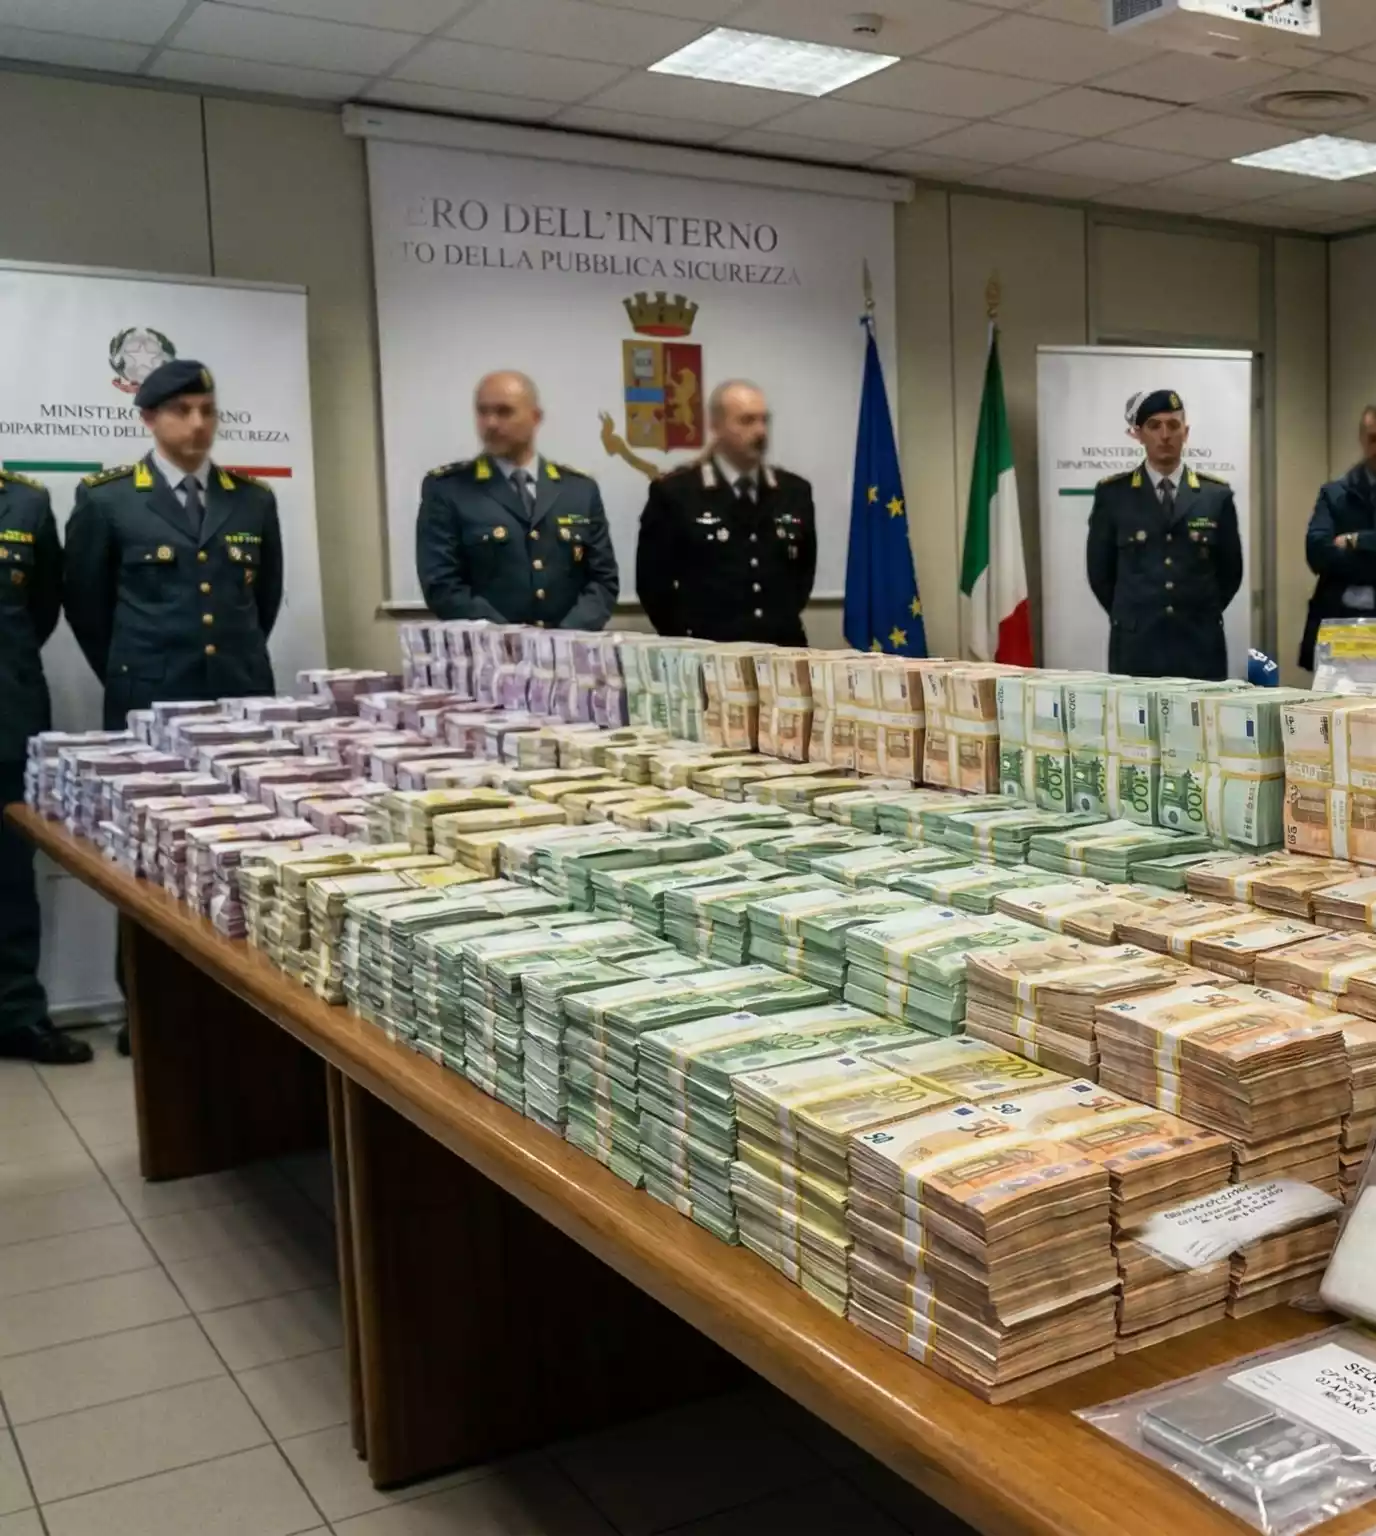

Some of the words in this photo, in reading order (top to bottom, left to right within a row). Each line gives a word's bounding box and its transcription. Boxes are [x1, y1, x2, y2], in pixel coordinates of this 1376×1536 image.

[444, 243, 533, 270] DELLA
[541, 249, 668, 278] PUBBLICA
[673, 258, 801, 286] SICUREZZA
